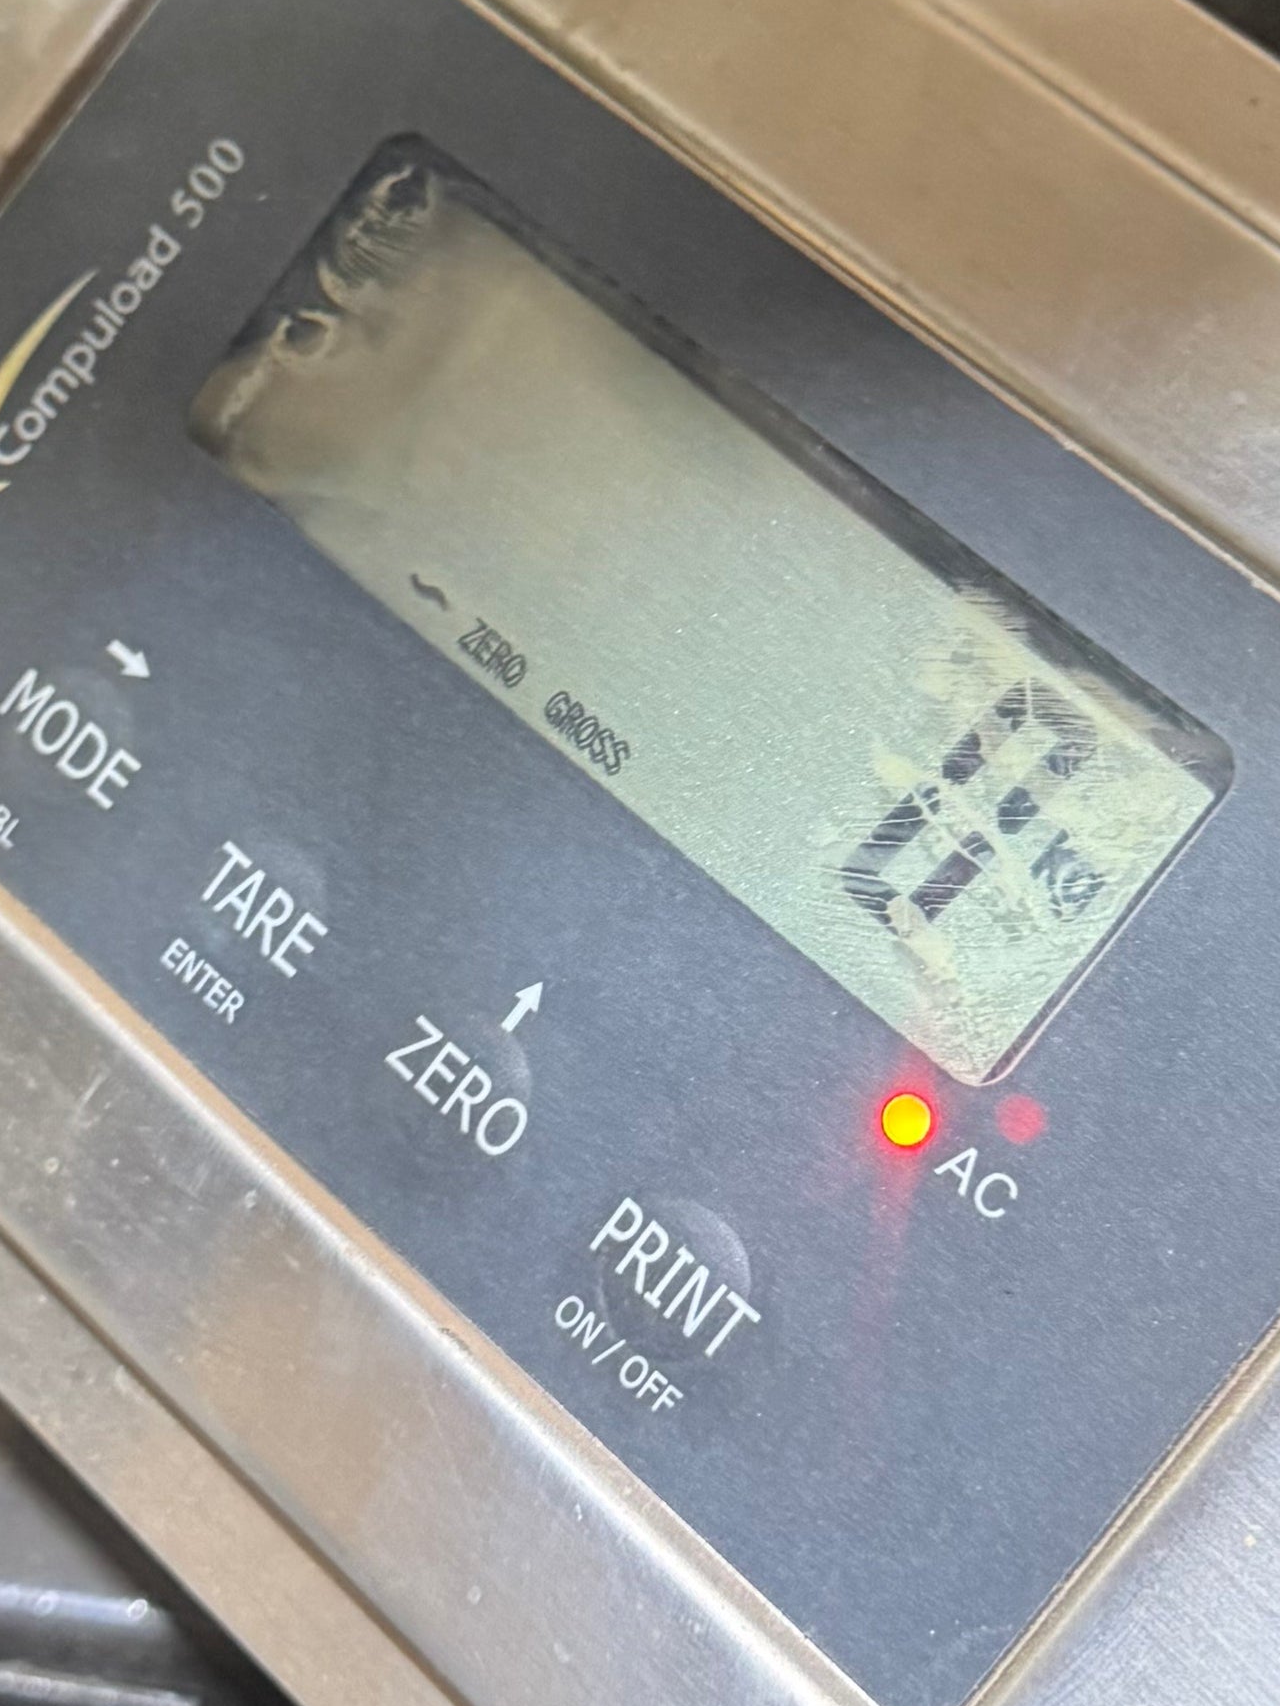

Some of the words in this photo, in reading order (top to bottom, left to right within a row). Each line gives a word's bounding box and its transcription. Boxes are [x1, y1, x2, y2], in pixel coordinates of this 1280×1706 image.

[172, 139, 244, 228] 500
[457, 617, 527, 688] ZERO
[544, 690, 631, 776] GROSS
[201, 841, 328, 978] TARE
[160, 937, 245, 1023] ENTER
[383, 1015, 528, 1155] ZERO
[934, 1147, 1019, 1218] AC
[589, 1197, 761, 1356] PRINT
[554, 1295, 607, 1349] ON
[619, 1354, 684, 1412] OFF
